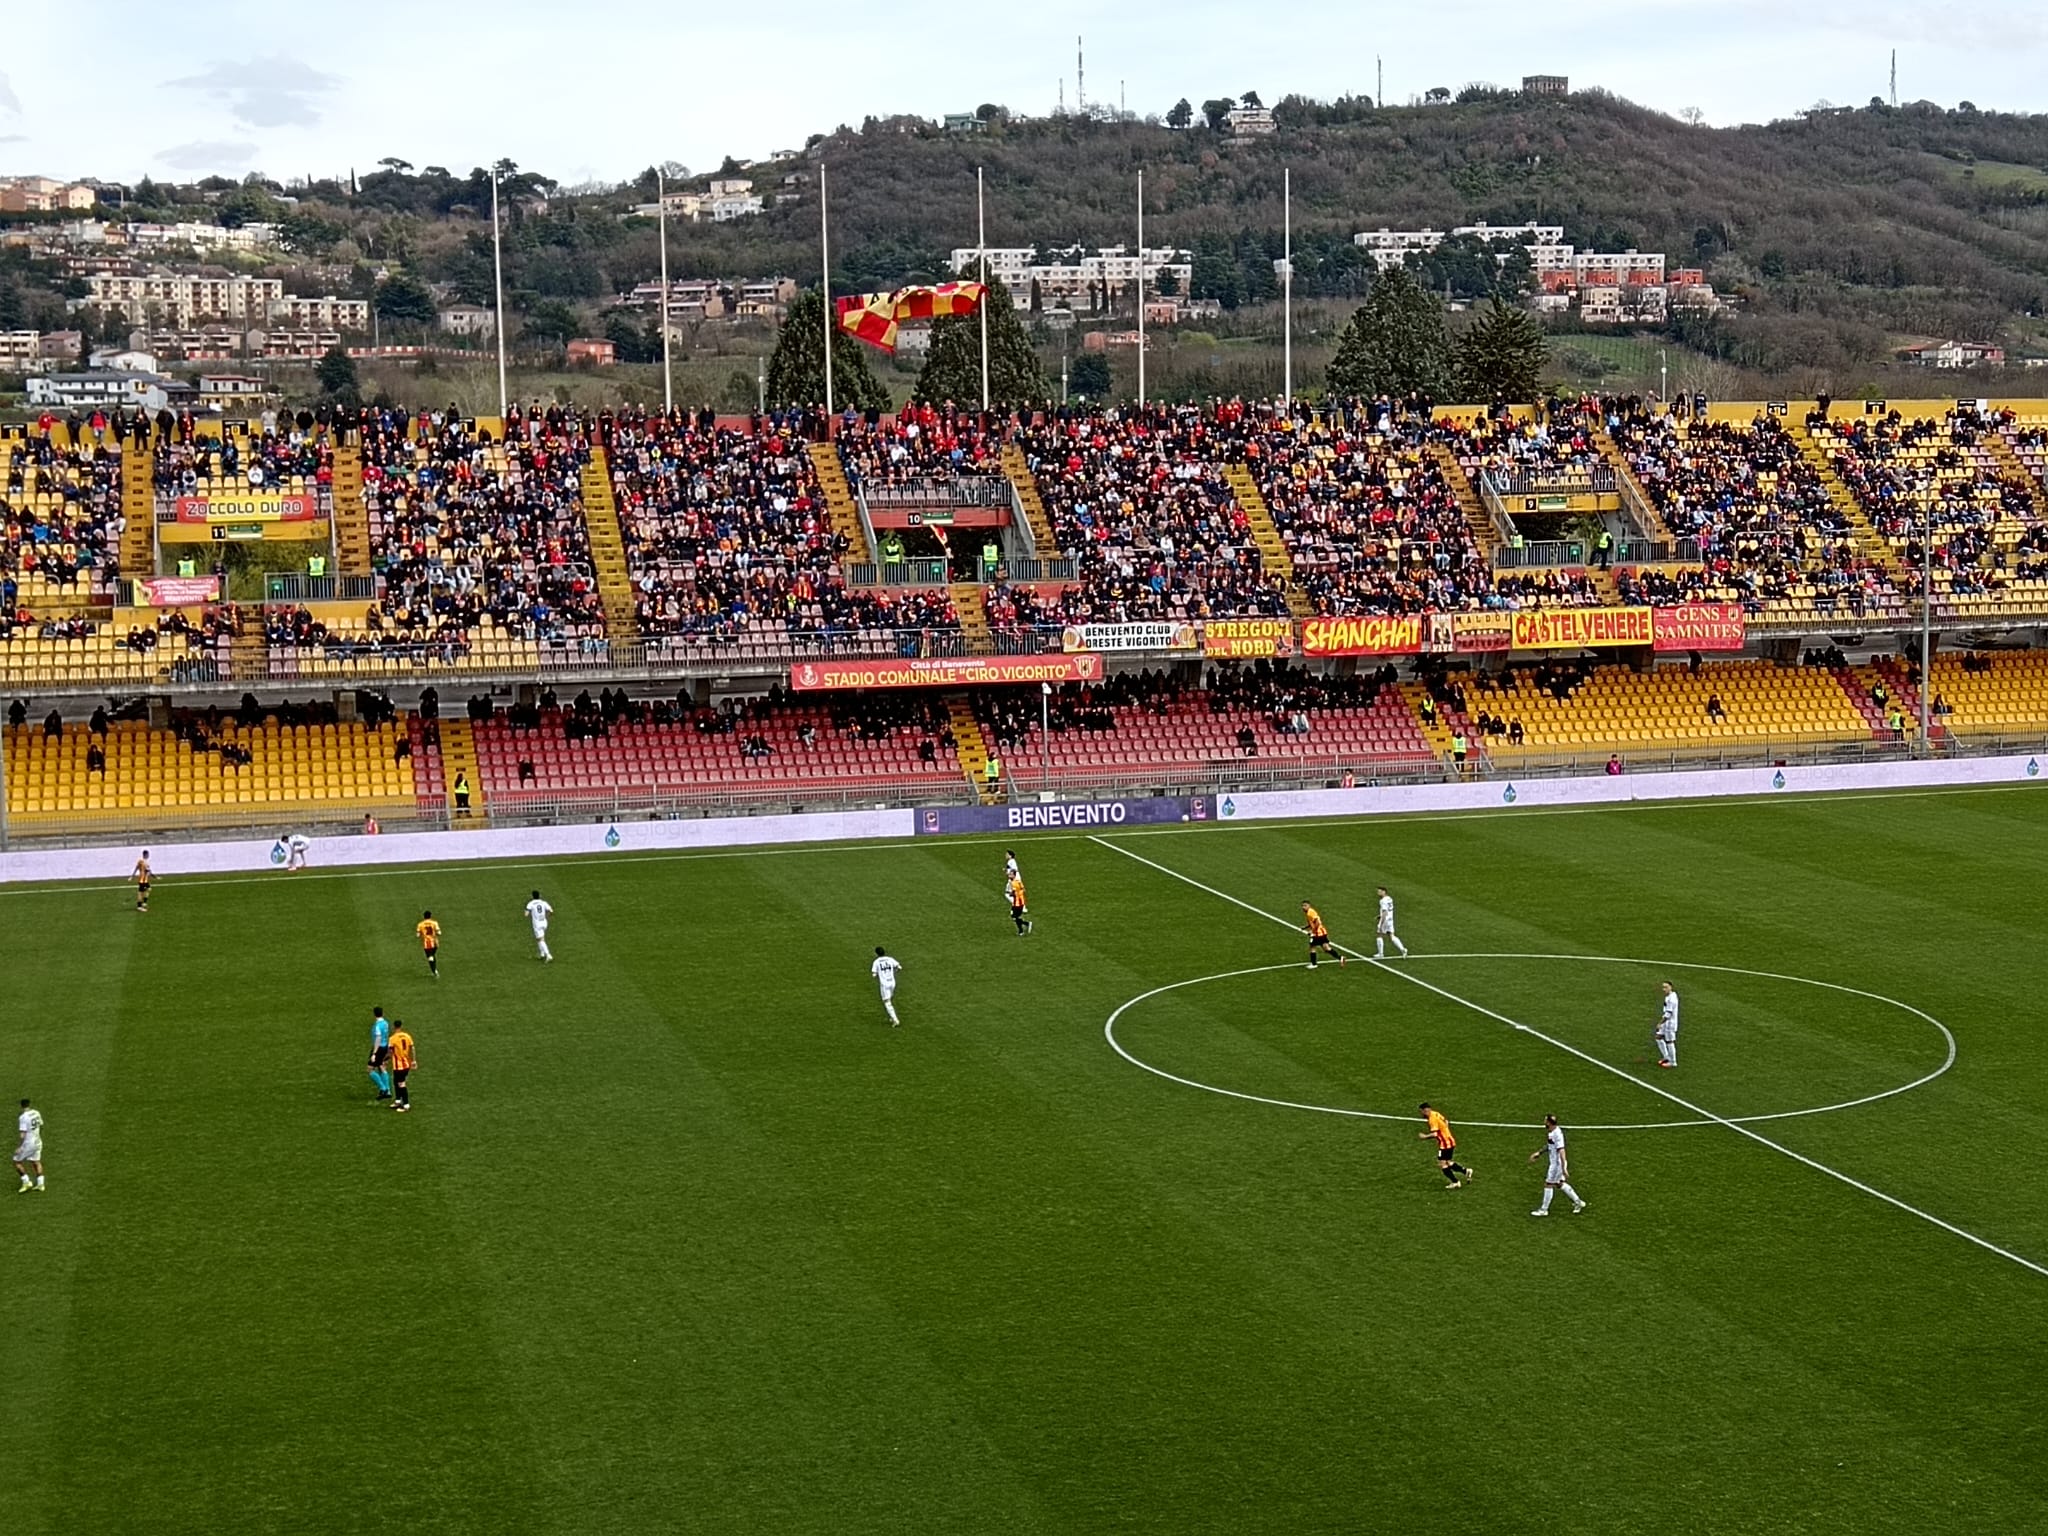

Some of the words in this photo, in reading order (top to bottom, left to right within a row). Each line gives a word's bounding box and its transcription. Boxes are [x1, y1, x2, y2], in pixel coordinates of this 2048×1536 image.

[186, 502, 255, 516] ZOCCOLO
[260, 501, 303, 514] DURO
[1528, 500, 1534, 509] 9
[909, 514, 920, 523] 10
[212, 527, 225, 538] 11
[1675, 607, 1720, 621] GENS
[1085, 626, 1143, 637] BENEVENTO
[1146, 625, 1171, 635] CLUB
[1305, 619, 1419, 651] SHANGHAI
[1515, 611, 1650, 645] CASTELVENERE
[1655, 624, 1741, 639] SAMNITES
[1085, 637, 1123, 648] ORESTE
[1125, 636, 1172, 647] VIGORITO
[1206, 647, 1228, 656] DEL
[1231, 639, 1275, 656] NORD
[911, 661, 930, 669] Città
[932, 660, 940, 669] di
[941, 660, 986, 668] Benevento
[824, 671, 875, 686] STADIO
[878, 669, 957, 684] COMUNALE
[1008, 803, 1125, 827] BENEVENTO
